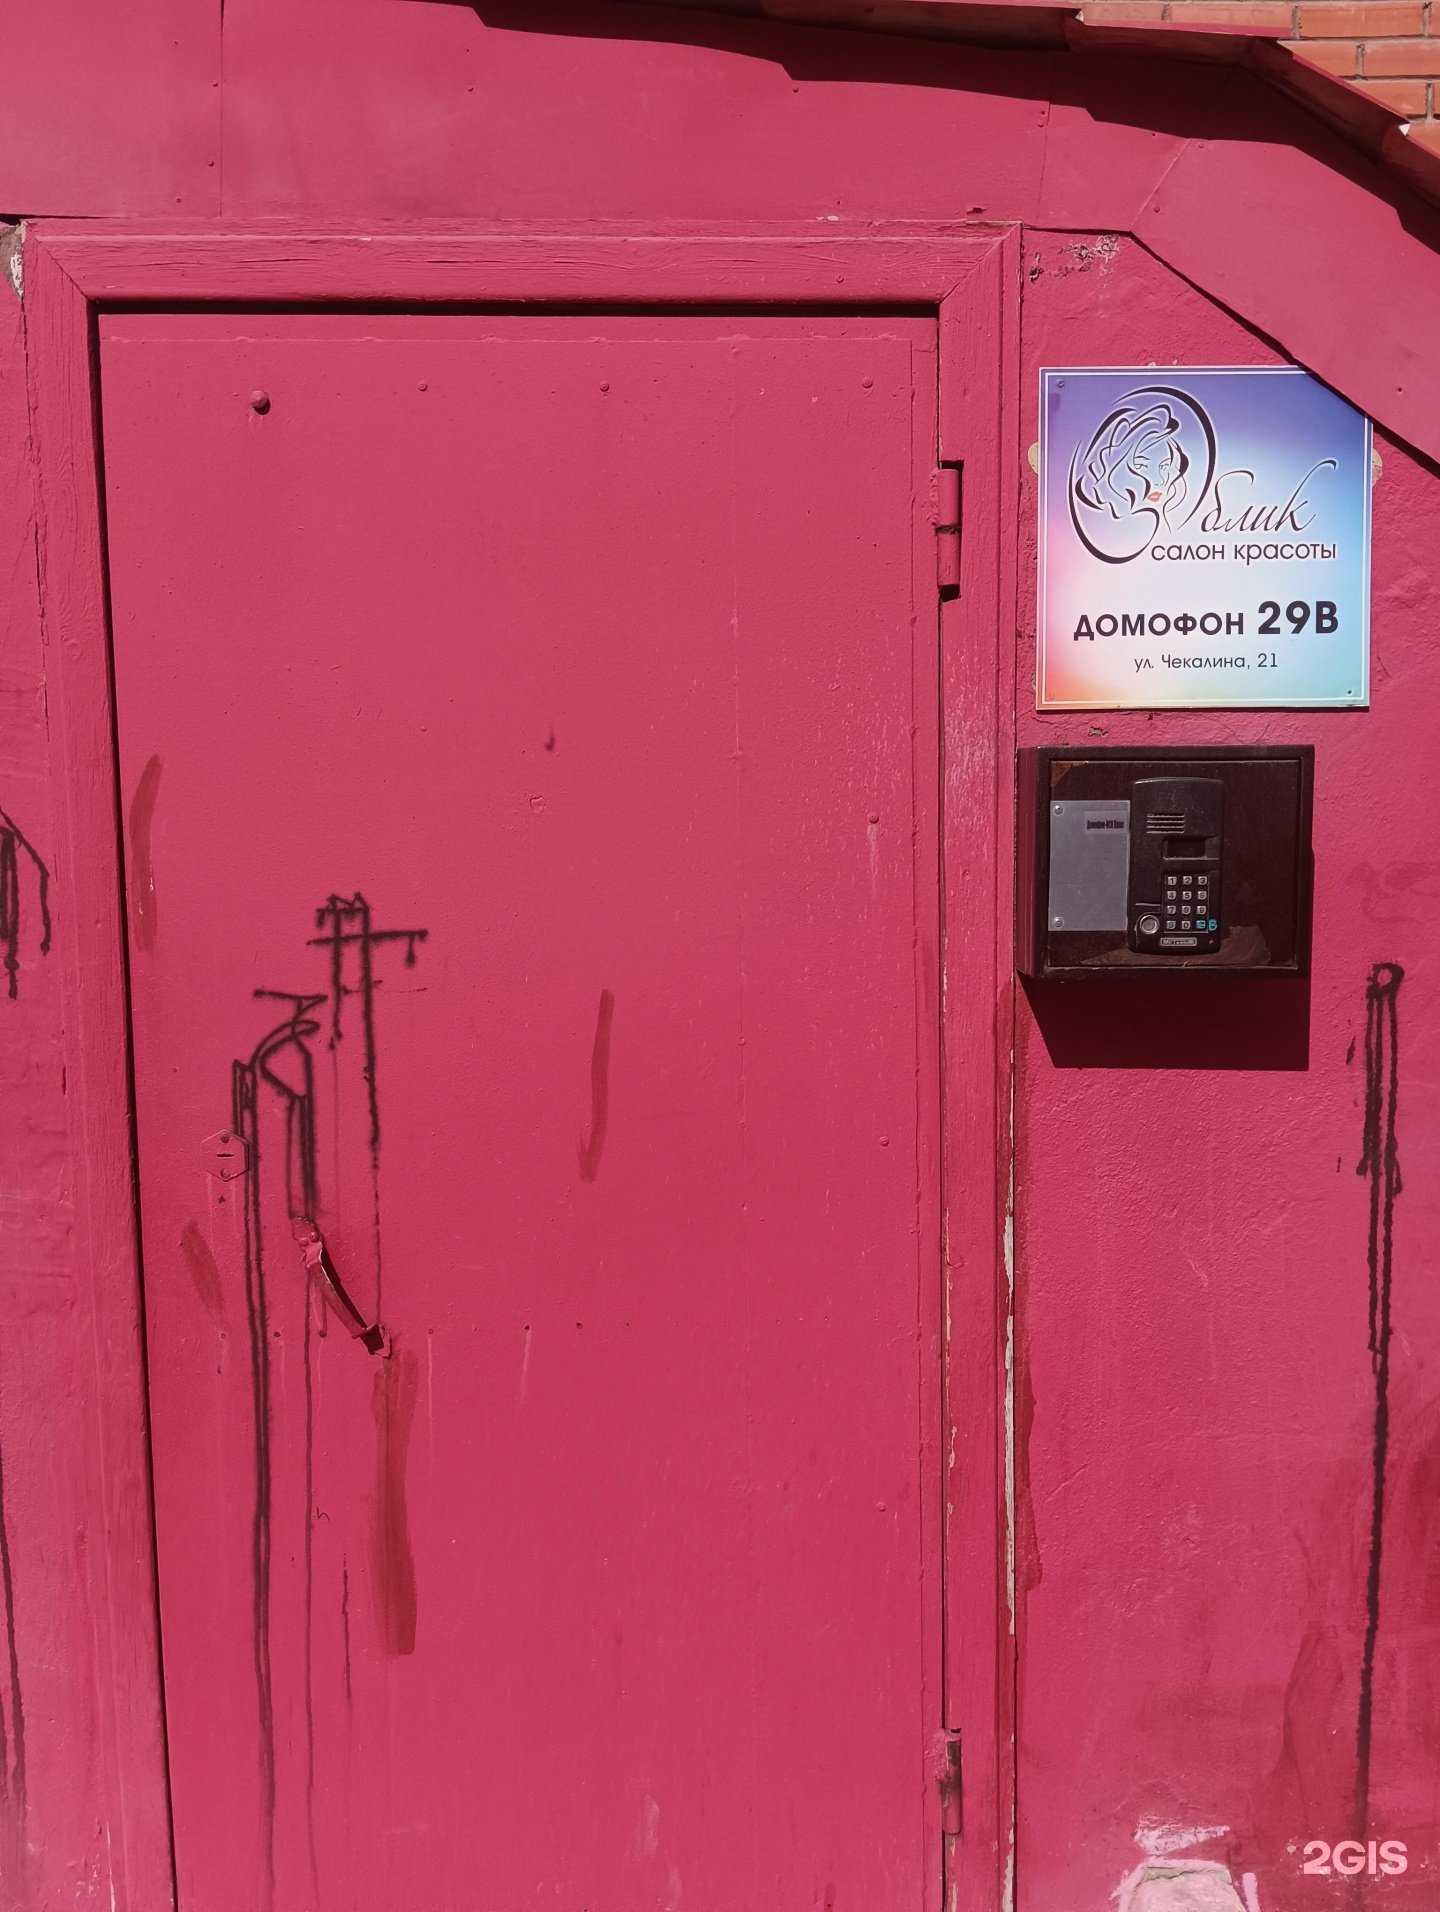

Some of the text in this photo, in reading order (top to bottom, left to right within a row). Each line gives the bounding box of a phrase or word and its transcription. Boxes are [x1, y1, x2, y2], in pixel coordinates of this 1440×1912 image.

[1151, 542, 1336, 566] салон красоты
[1073, 600, 1339, 641] ДОМОФОН 29В
[1134, 652, 1279, 673] ул. Чекалина, 21
